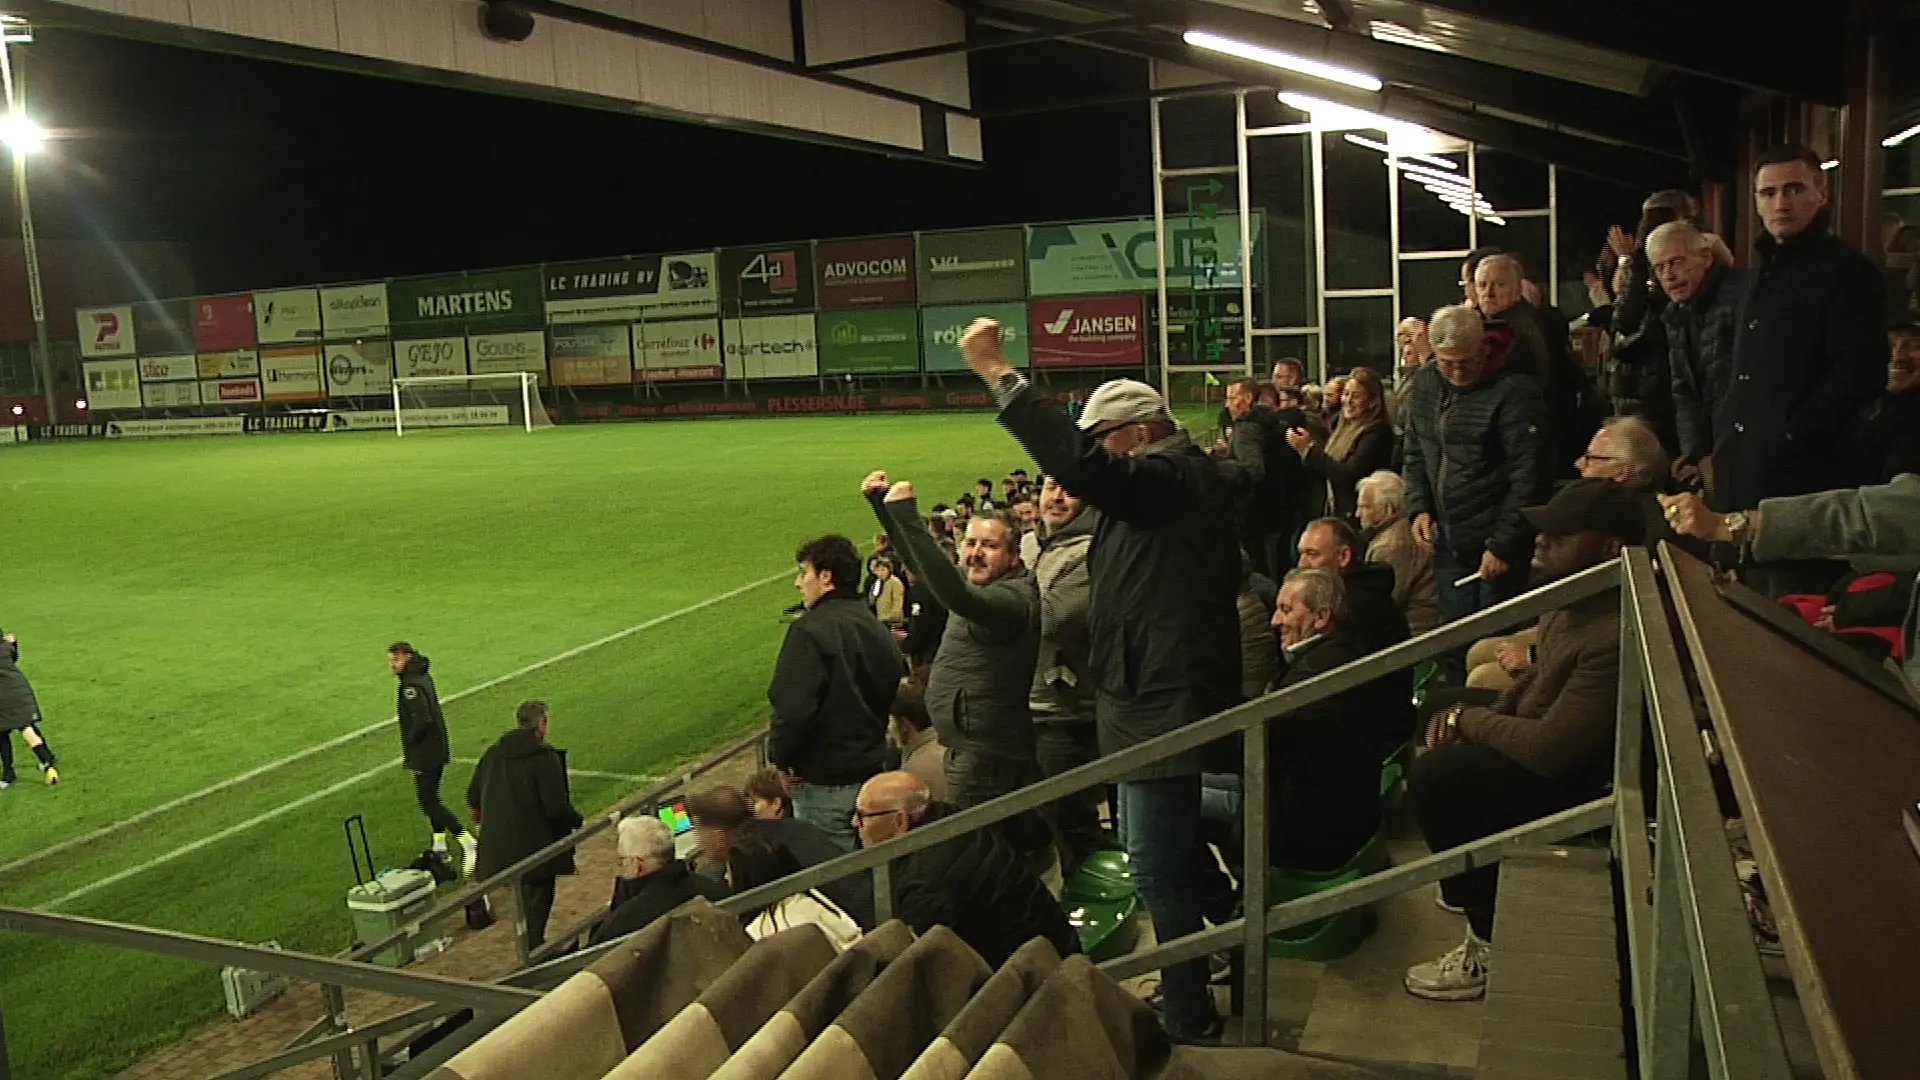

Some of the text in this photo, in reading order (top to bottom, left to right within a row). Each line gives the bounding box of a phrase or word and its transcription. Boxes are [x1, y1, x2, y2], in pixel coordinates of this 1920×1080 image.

[825, 259, 907, 278] ADVOCOM
[550, 270, 654, 290] LC TRADING BV
[417, 289, 512, 317] MARTENS
[1071, 315, 1136, 334] JANSEN
[637, 337, 689, 350] Carrefour
